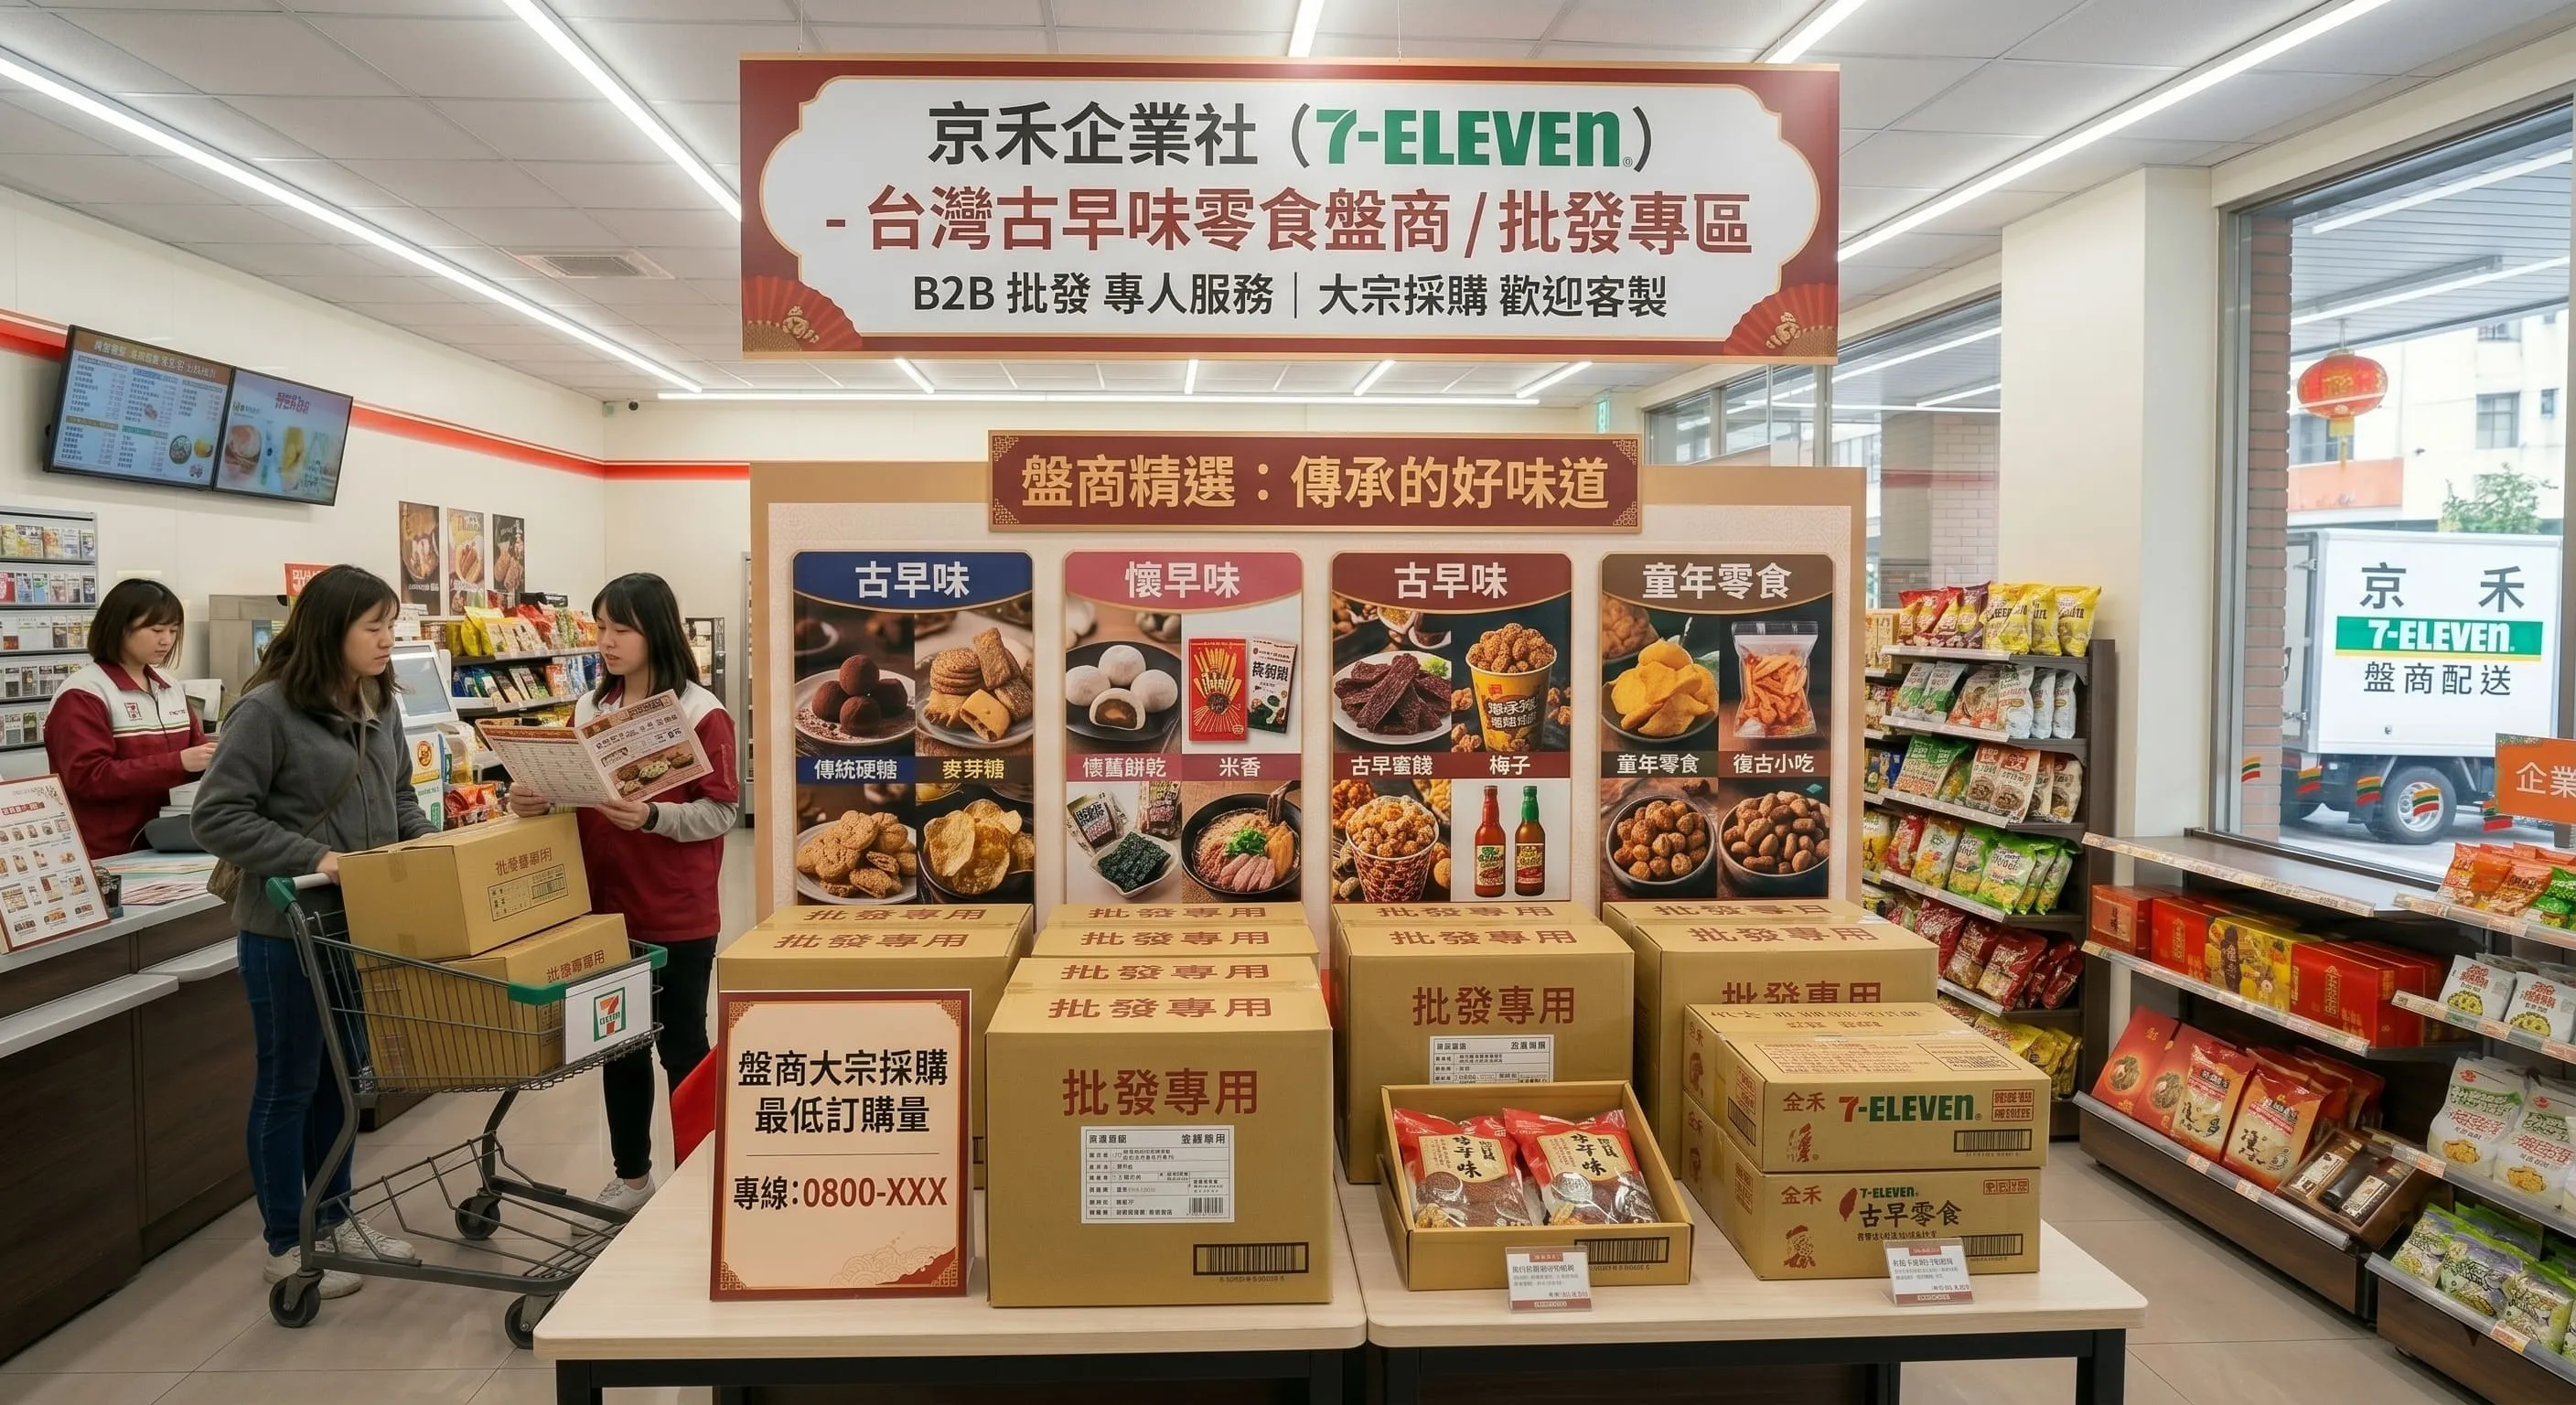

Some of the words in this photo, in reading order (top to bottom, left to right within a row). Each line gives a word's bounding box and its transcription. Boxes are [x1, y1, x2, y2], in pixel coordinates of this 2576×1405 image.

[928, 101, 1259, 166] 京禾企業社
[915, 275, 996, 310] B2B
[1007, 272, 1092, 315] 批發
[1499, 273, 1669, 318] 歡迎客製
[855, 560, 971, 599] 古早味
[1125, 561, 1241, 599] 懷早味
[1395, 561, 1509, 599] 古早味
[1642, 562, 1792, 600] 童年零食
[2364, 660, 2512, 696] 盤商配送
[1083, 756, 1168, 778] 懷舊餅乾
[1219, 756, 1262, 778] 米香
[1490, 755, 1532, 776] 梅子
[1617, 753, 1701, 775] 童年零食
[1733, 753, 1816, 774] 復古小吃
[805, 908, 988, 921] 批發專用
[1089, 906, 1268, 918] 批發專用
[773, 933, 970, 949] 批發專用
[1081, 931, 1271, 946] 批發專用
[1390, 929, 1579, 945] 批發專用
[1689, 927, 1880, 942] 批發專用
[1061, 964, 1271, 981] 批發專用
[1048, 997, 1272, 1019] 批發專用
[1412, 985, 1575, 1026] 批發專用
[738, 1048, 950, 1087] 盤商大宗採購
[1063, 1067, 1259, 1117] 批發專用
[1783, 1091, 1826, 1112] 金禾
[756, 1095, 931, 1134] 最低訂購量
[1781, 1185, 1823, 1206] 金禾
[1859, 1199, 1963, 1228] 古早零食
